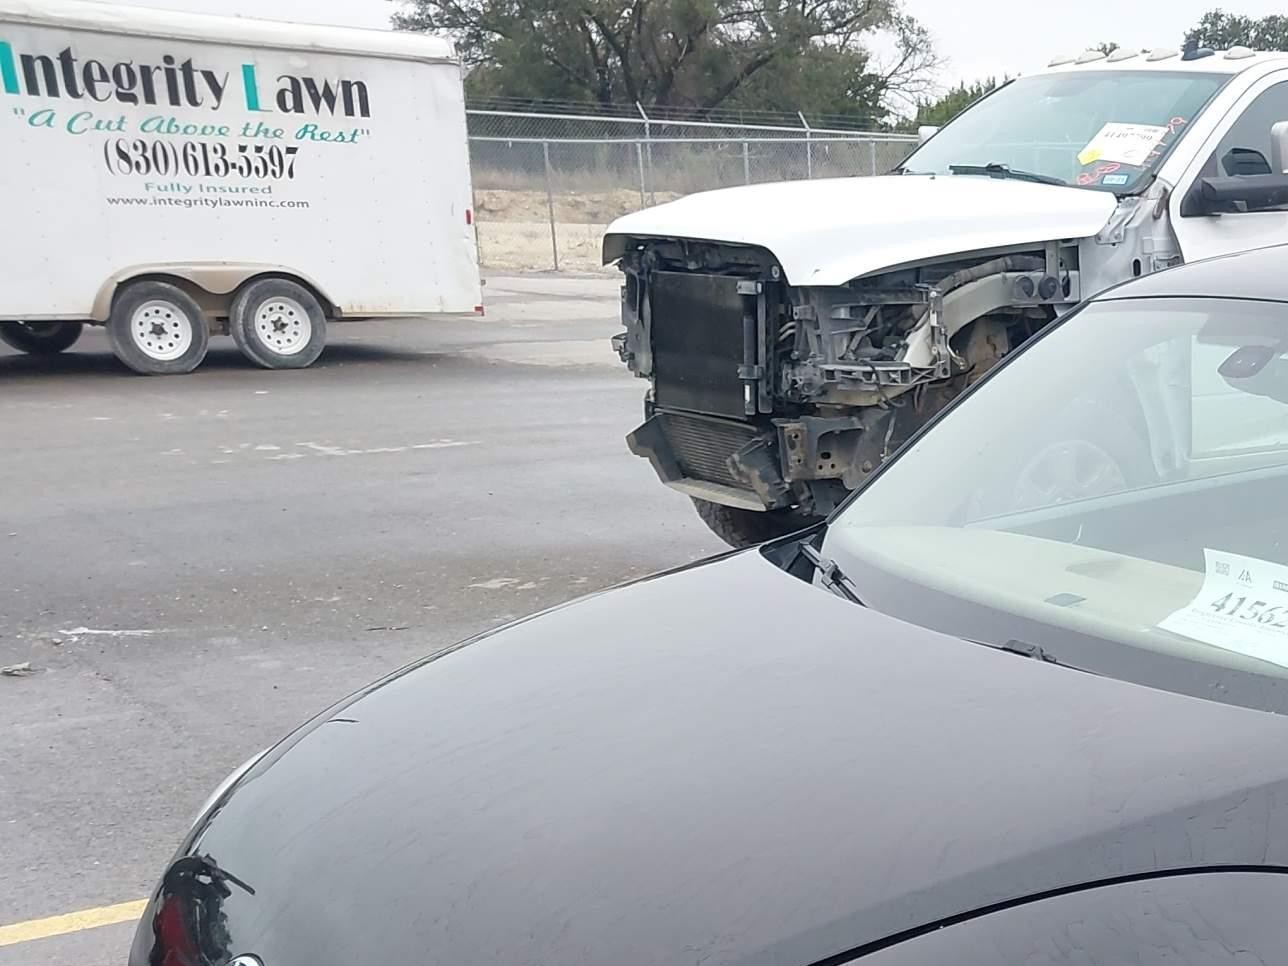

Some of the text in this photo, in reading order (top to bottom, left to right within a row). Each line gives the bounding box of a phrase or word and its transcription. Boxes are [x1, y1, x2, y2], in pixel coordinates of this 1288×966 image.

[0, 41, 371, 118] Integrity Lawn
[67, 111, 127, 134] Cut
[140, 115, 230, 137] Above
[239, 122, 284, 139] the
[295, 123, 370, 144] Rest"
[145, 182, 273, 195] Fully Insured
[107, 196, 310, 209] www.integritylawninc.com
